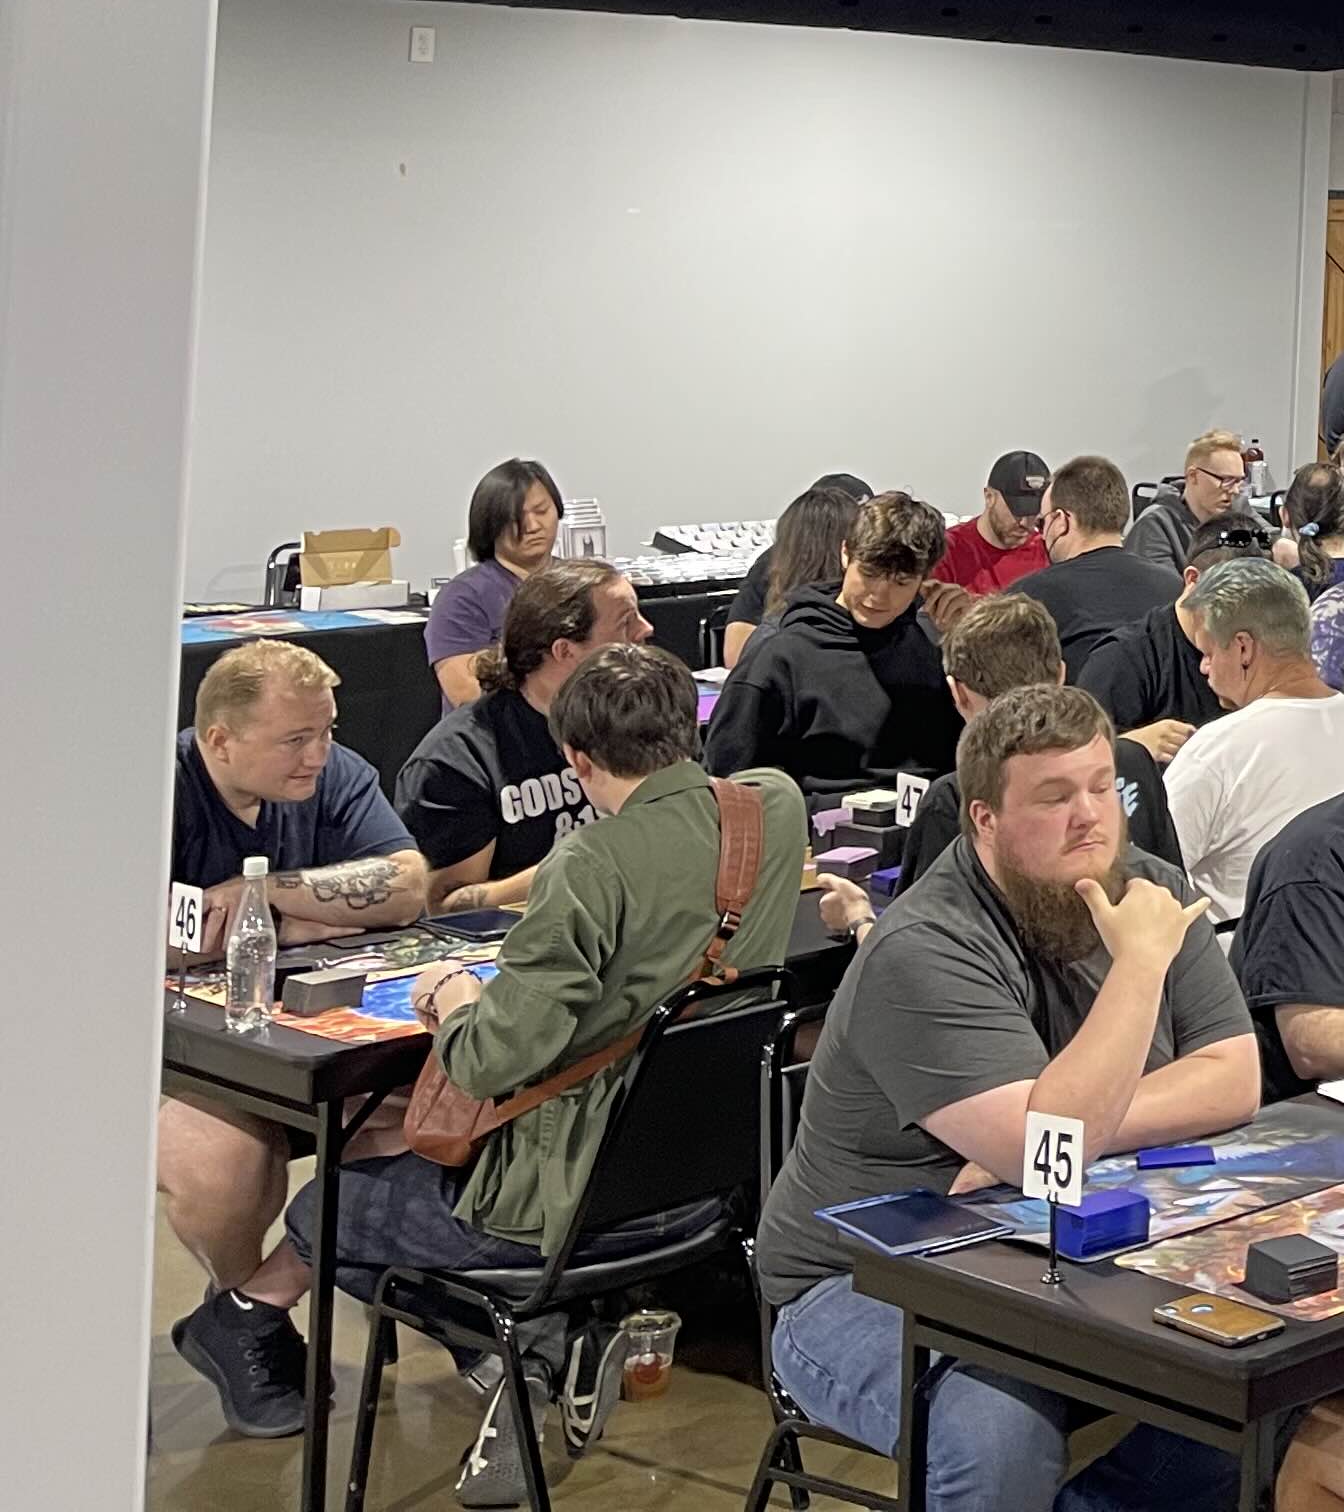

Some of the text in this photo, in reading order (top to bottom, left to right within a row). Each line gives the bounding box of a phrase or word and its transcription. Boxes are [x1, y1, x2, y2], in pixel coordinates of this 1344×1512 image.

[901, 784, 923, 818] 47
[175, 895, 197, 940] 46
[1033, 1129, 1073, 1189] 45
